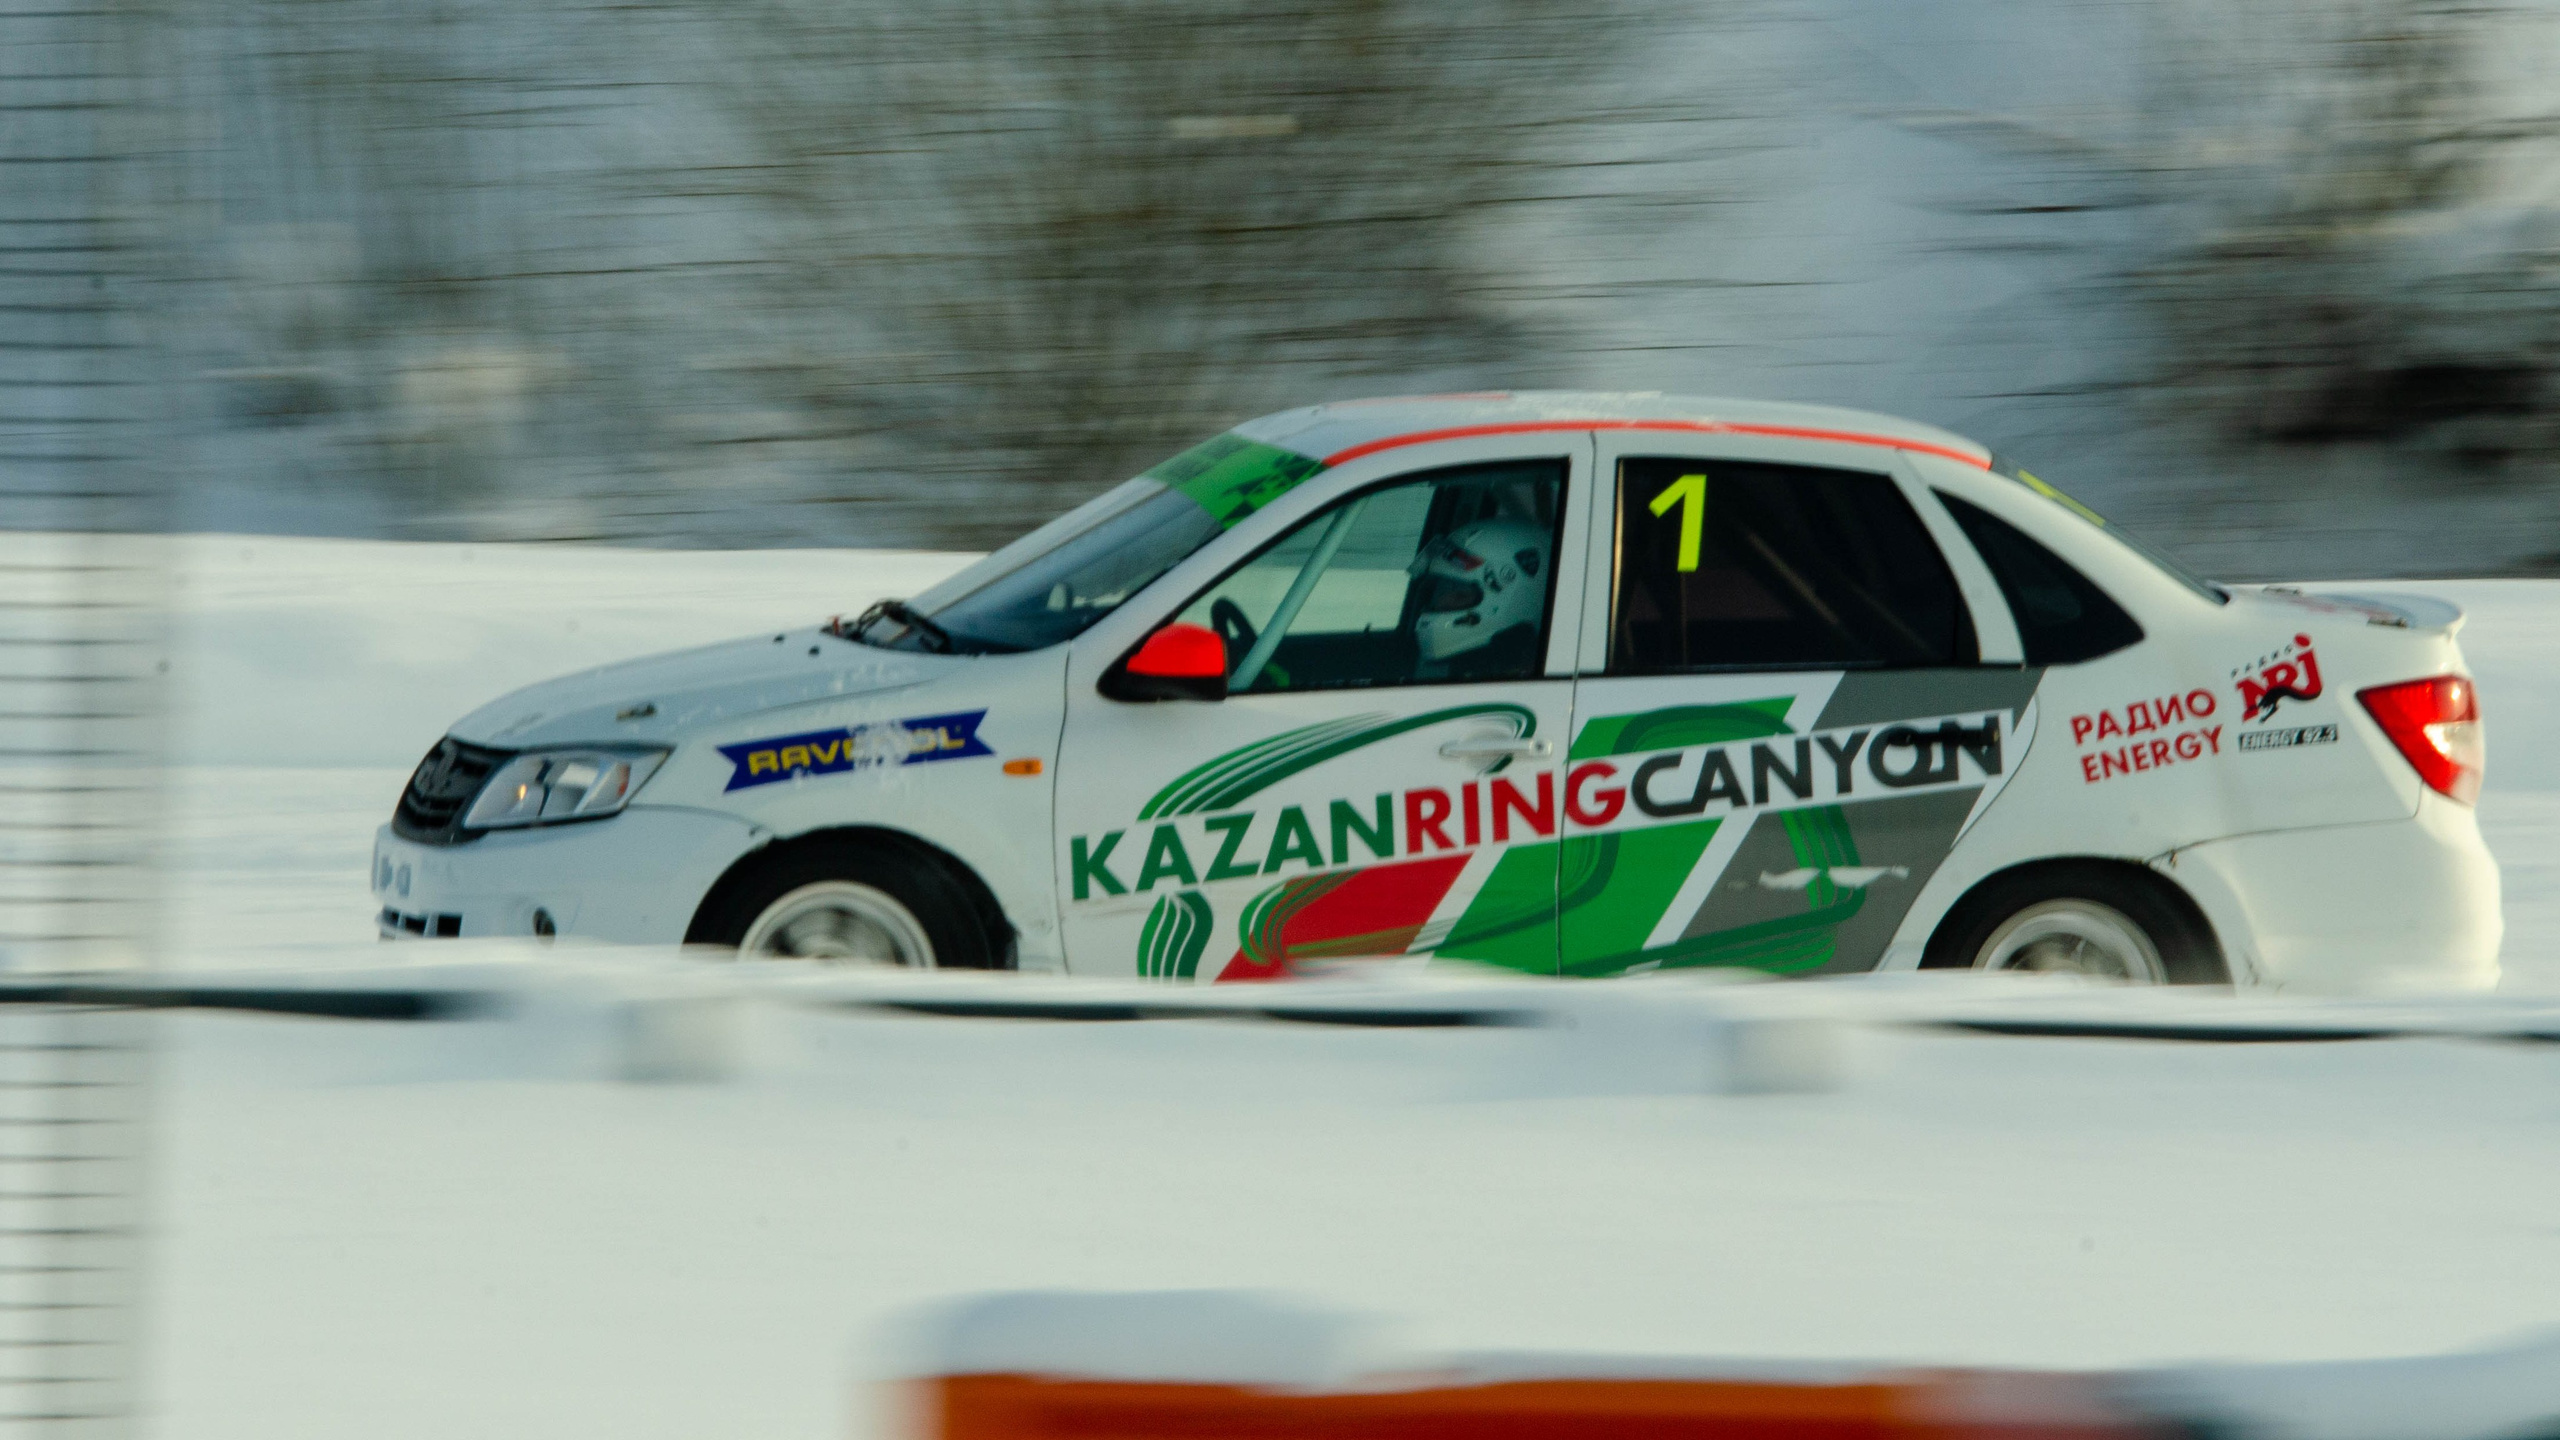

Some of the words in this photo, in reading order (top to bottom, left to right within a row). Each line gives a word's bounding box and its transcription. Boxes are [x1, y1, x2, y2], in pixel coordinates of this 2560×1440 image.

[1649, 474, 1706, 572] 1
[2070, 688, 2217, 746] РАДИО
[2240, 727, 2300, 750] ENERGY
[748, 726, 966, 776] RAVOL
[2081, 725, 2223, 784] ENERGY
